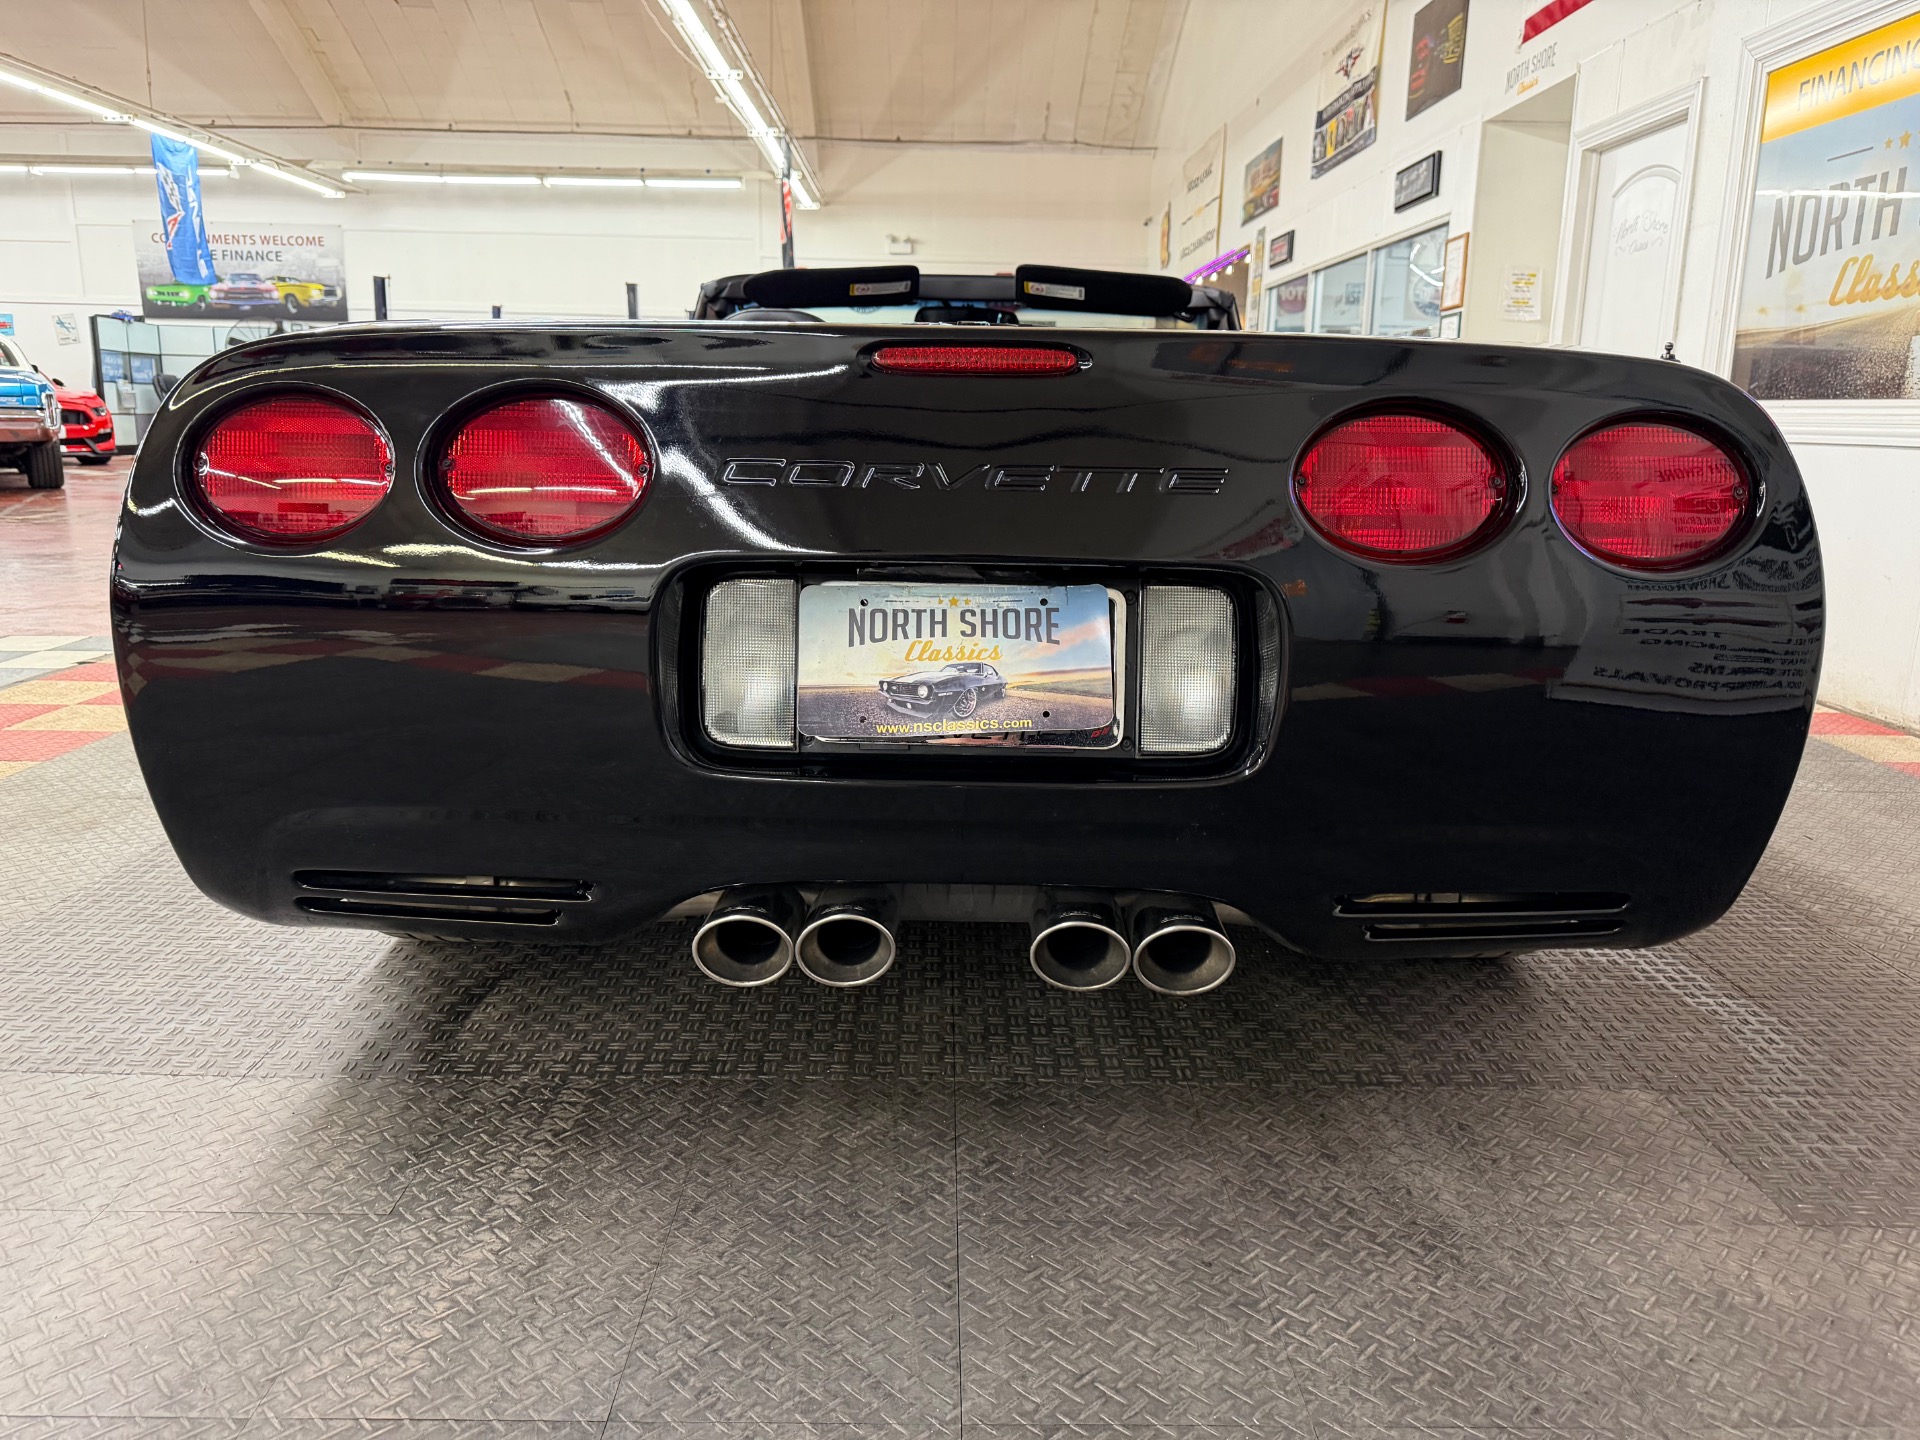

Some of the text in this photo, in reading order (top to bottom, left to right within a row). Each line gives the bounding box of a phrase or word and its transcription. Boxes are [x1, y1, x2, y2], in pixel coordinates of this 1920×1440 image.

[1504, 42, 1557, 95] NORTH SHORE
[259, 234, 325, 247] WELCOME
[1765, 166, 1908, 280] NORTH
[221, 249, 283, 262] FINANCE
[1828, 253, 1920, 307] Class
[716, 456, 1229, 494] CORVETTE
[848, 607, 1061, 648] NORTH SHORE
[904, 639, 1003, 662] Classics
[876, 717, 1032, 734] www.nsclassics.com
